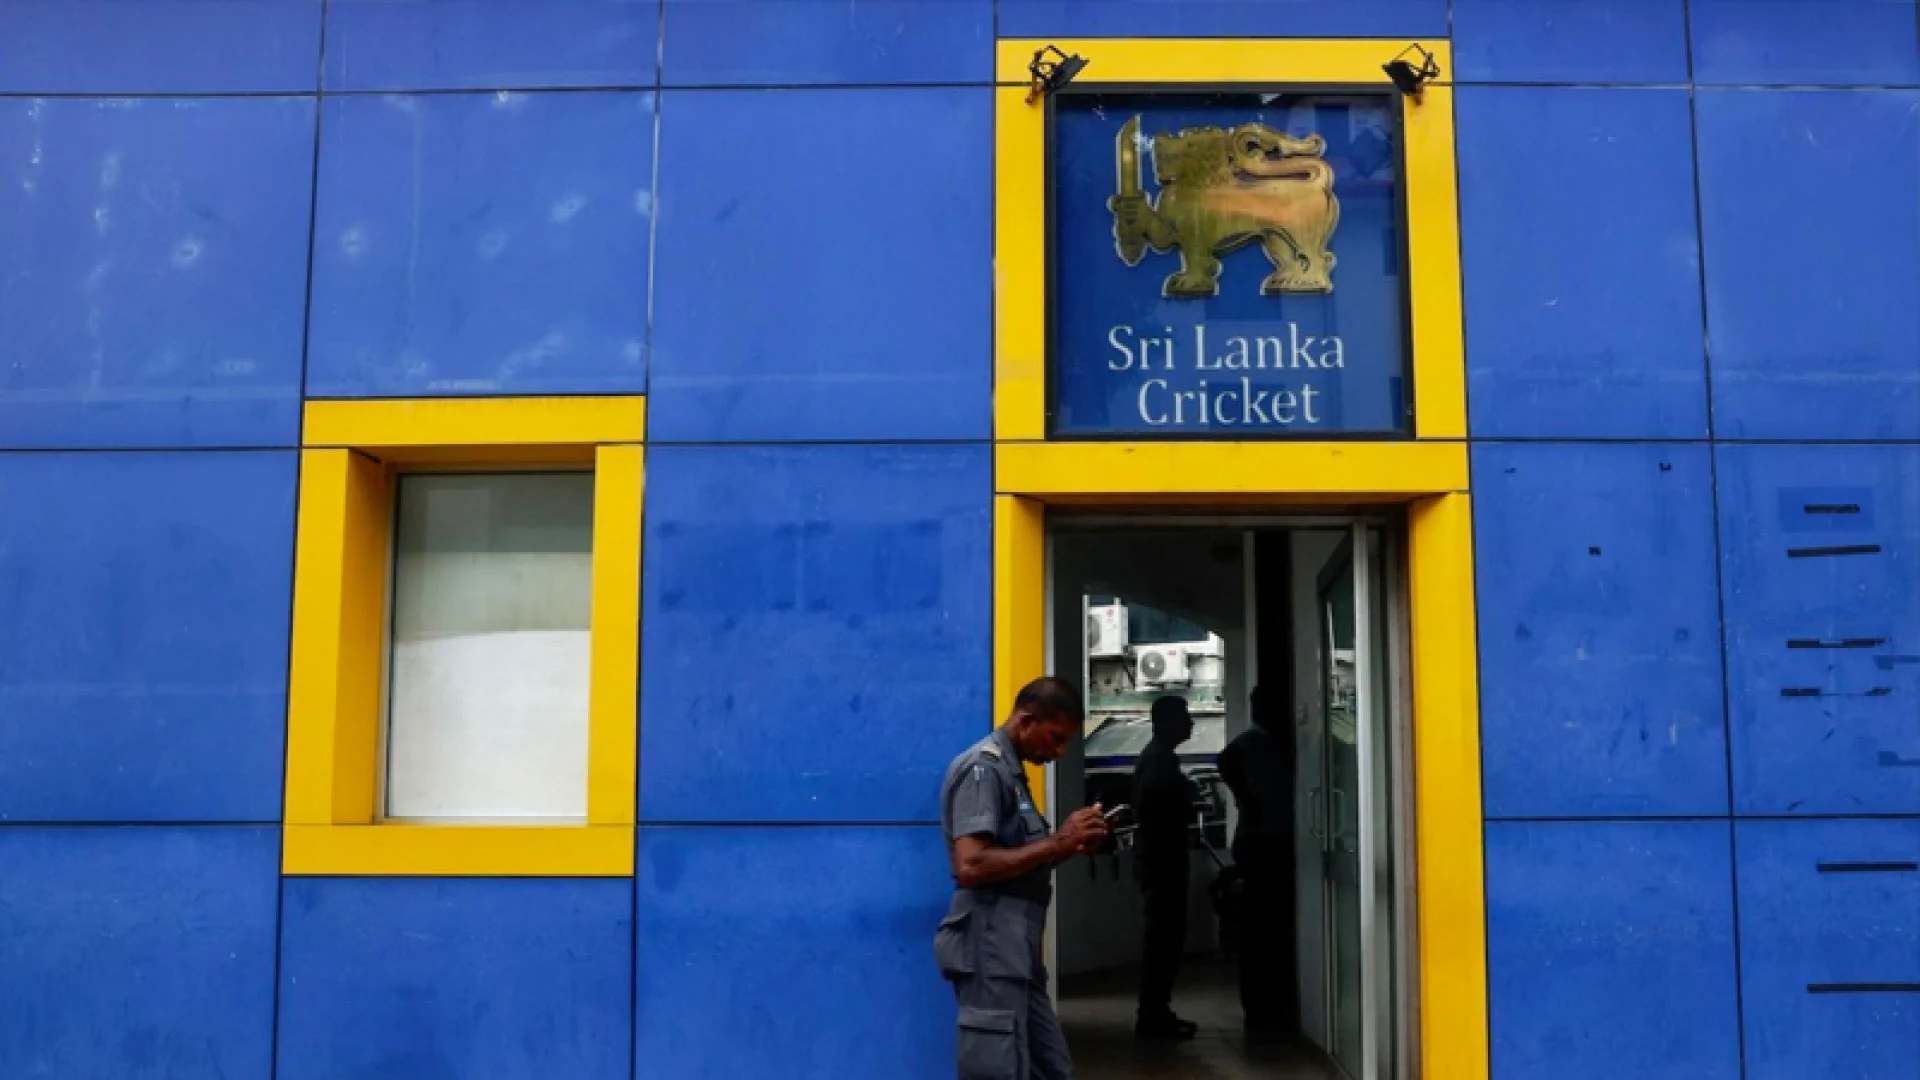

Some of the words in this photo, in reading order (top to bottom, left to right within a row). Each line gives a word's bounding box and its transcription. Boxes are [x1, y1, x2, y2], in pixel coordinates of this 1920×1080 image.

[1108, 325, 1174, 371] Sri
[1194, 322, 1345, 369] Lanka
[1138, 377, 1320, 424] Cricket
